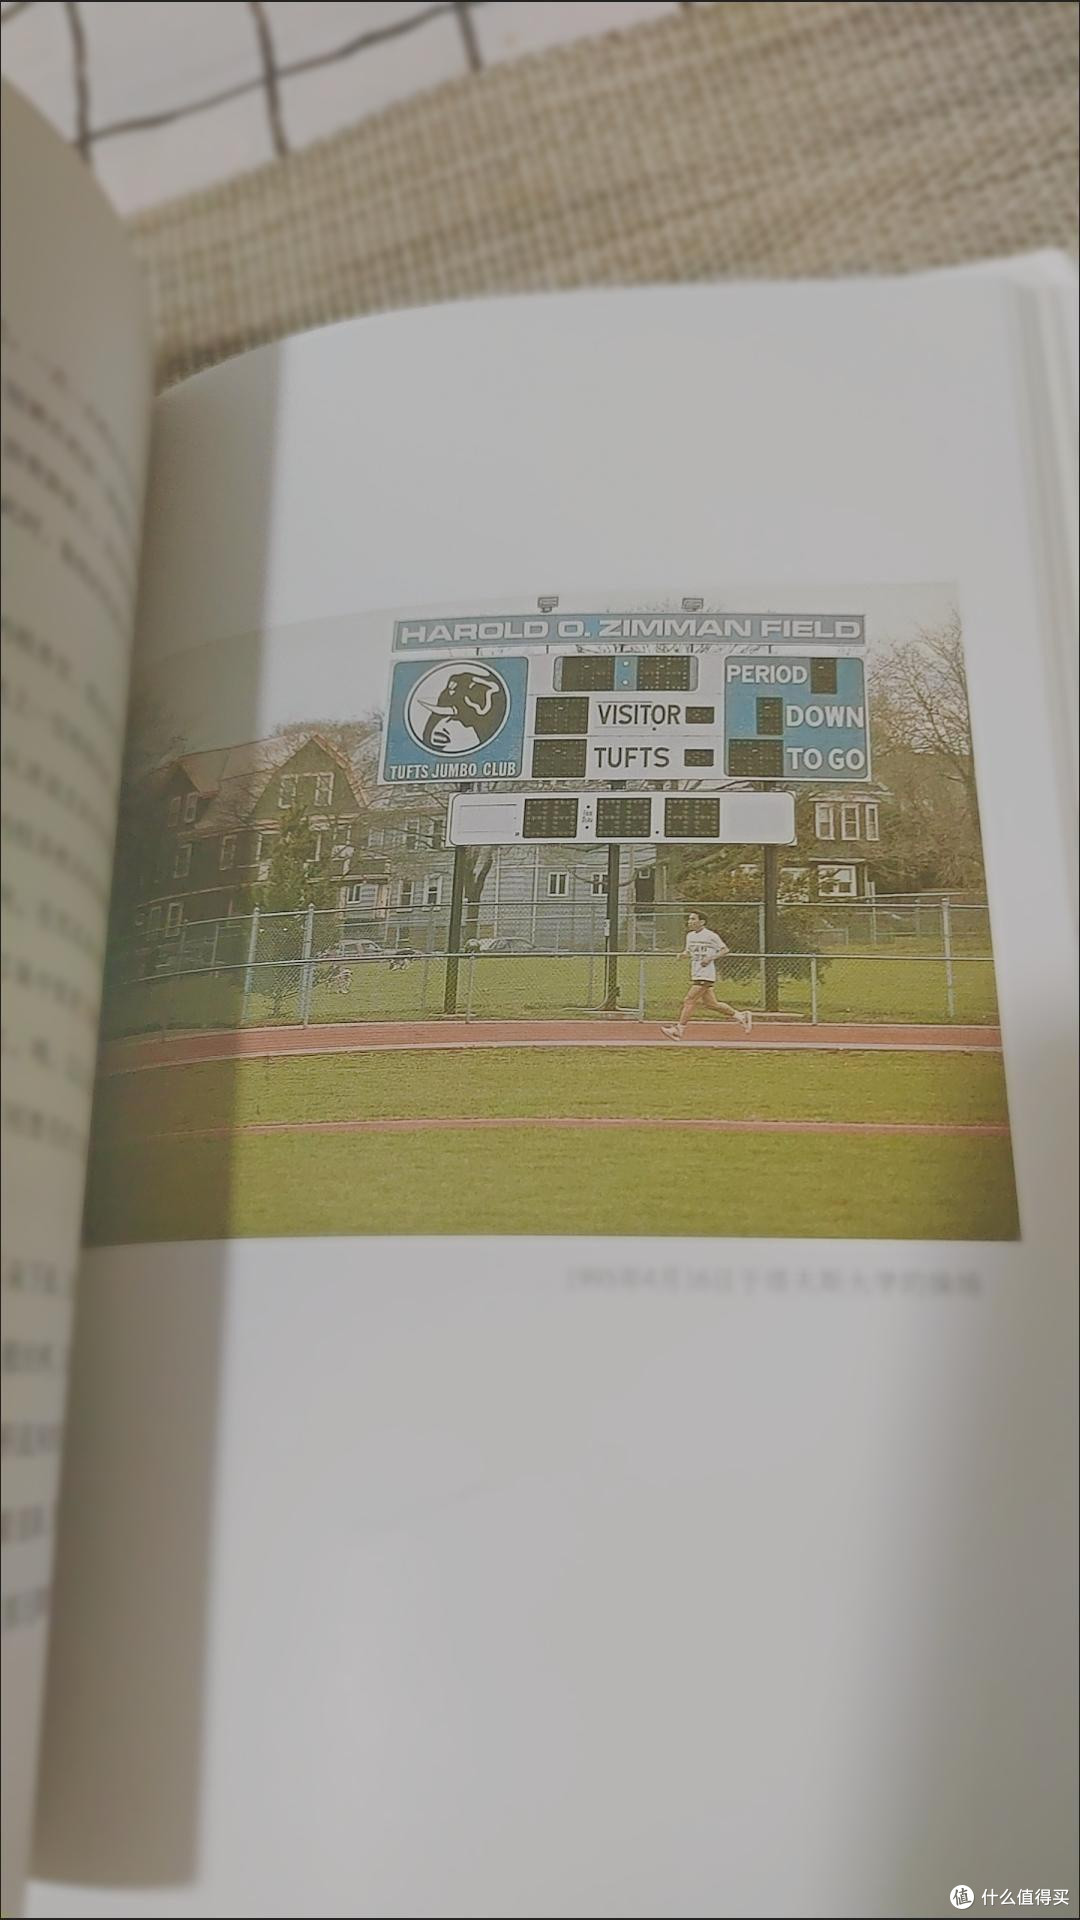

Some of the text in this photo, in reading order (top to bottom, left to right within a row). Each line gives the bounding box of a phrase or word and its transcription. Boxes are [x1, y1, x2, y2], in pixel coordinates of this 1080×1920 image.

[401, 619, 862, 645] HAROLD O. ZIMMAN FIELD
[726, 664, 808, 684] PERIOD
[598, 704, 681, 725] VISITOR
[785, 704, 864, 728] DOWN
[594, 746, 670, 768] TUFTS
[786, 747, 866, 770] TO GO
[389, 761, 517, 780] TUFTS JUMBO CLUB
